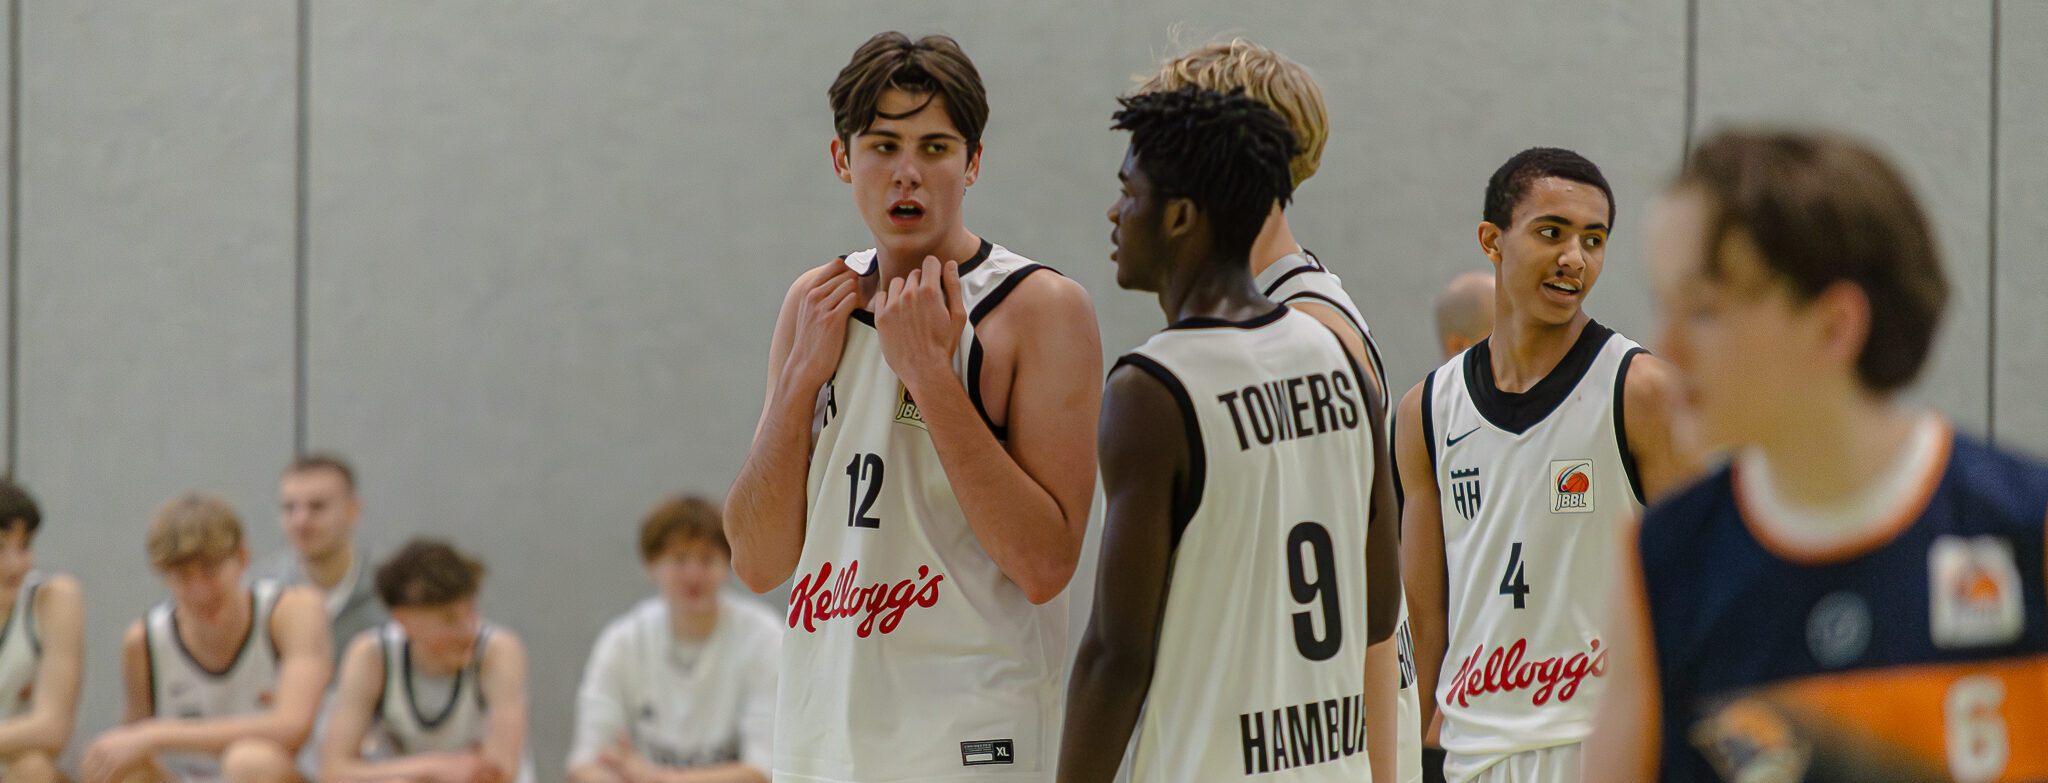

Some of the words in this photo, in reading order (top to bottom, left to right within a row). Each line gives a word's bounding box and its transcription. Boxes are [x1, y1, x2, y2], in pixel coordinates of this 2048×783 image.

[896, 401, 922, 420] JBB
[1217, 369, 1359, 451] TOWERS
[845, 453, 885, 529] 12
[1555, 492, 1587, 511] JBBL
[788, 559, 945, 638] Kellogg's
[1286, 521, 1342, 661] 9
[1499, 541, 1530, 610] 4
[1446, 638, 1609, 708] Kellogg's
[995, 746, 1010, 757] XL
[1239, 693, 1367, 775] HAMBU
[1943, 675, 2010, 783] 6
